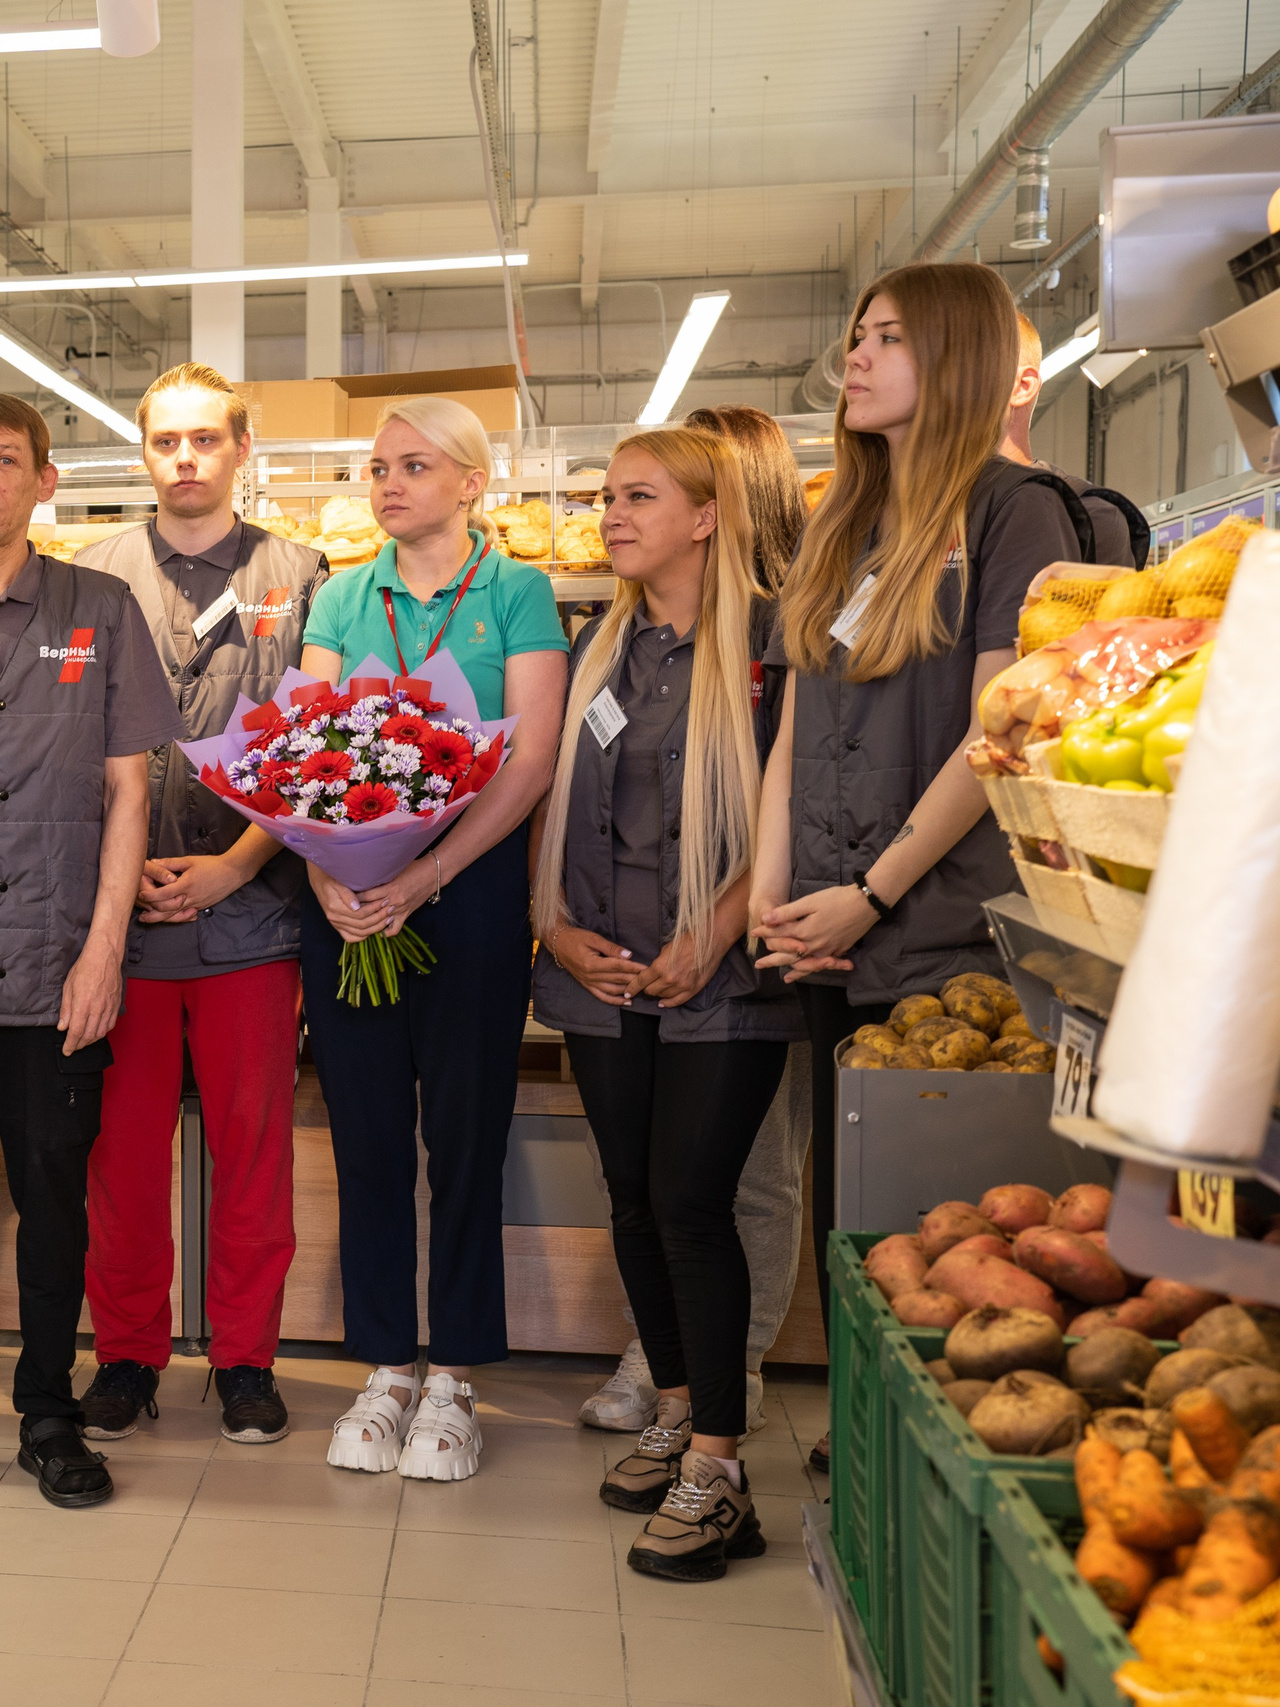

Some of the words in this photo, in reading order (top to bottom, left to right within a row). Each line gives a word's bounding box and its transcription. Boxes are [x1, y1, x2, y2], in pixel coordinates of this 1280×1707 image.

[235, 598, 294, 615] Верный
[39, 644, 96, 661] Верный
[1060, 1044, 1084, 1115] 79
